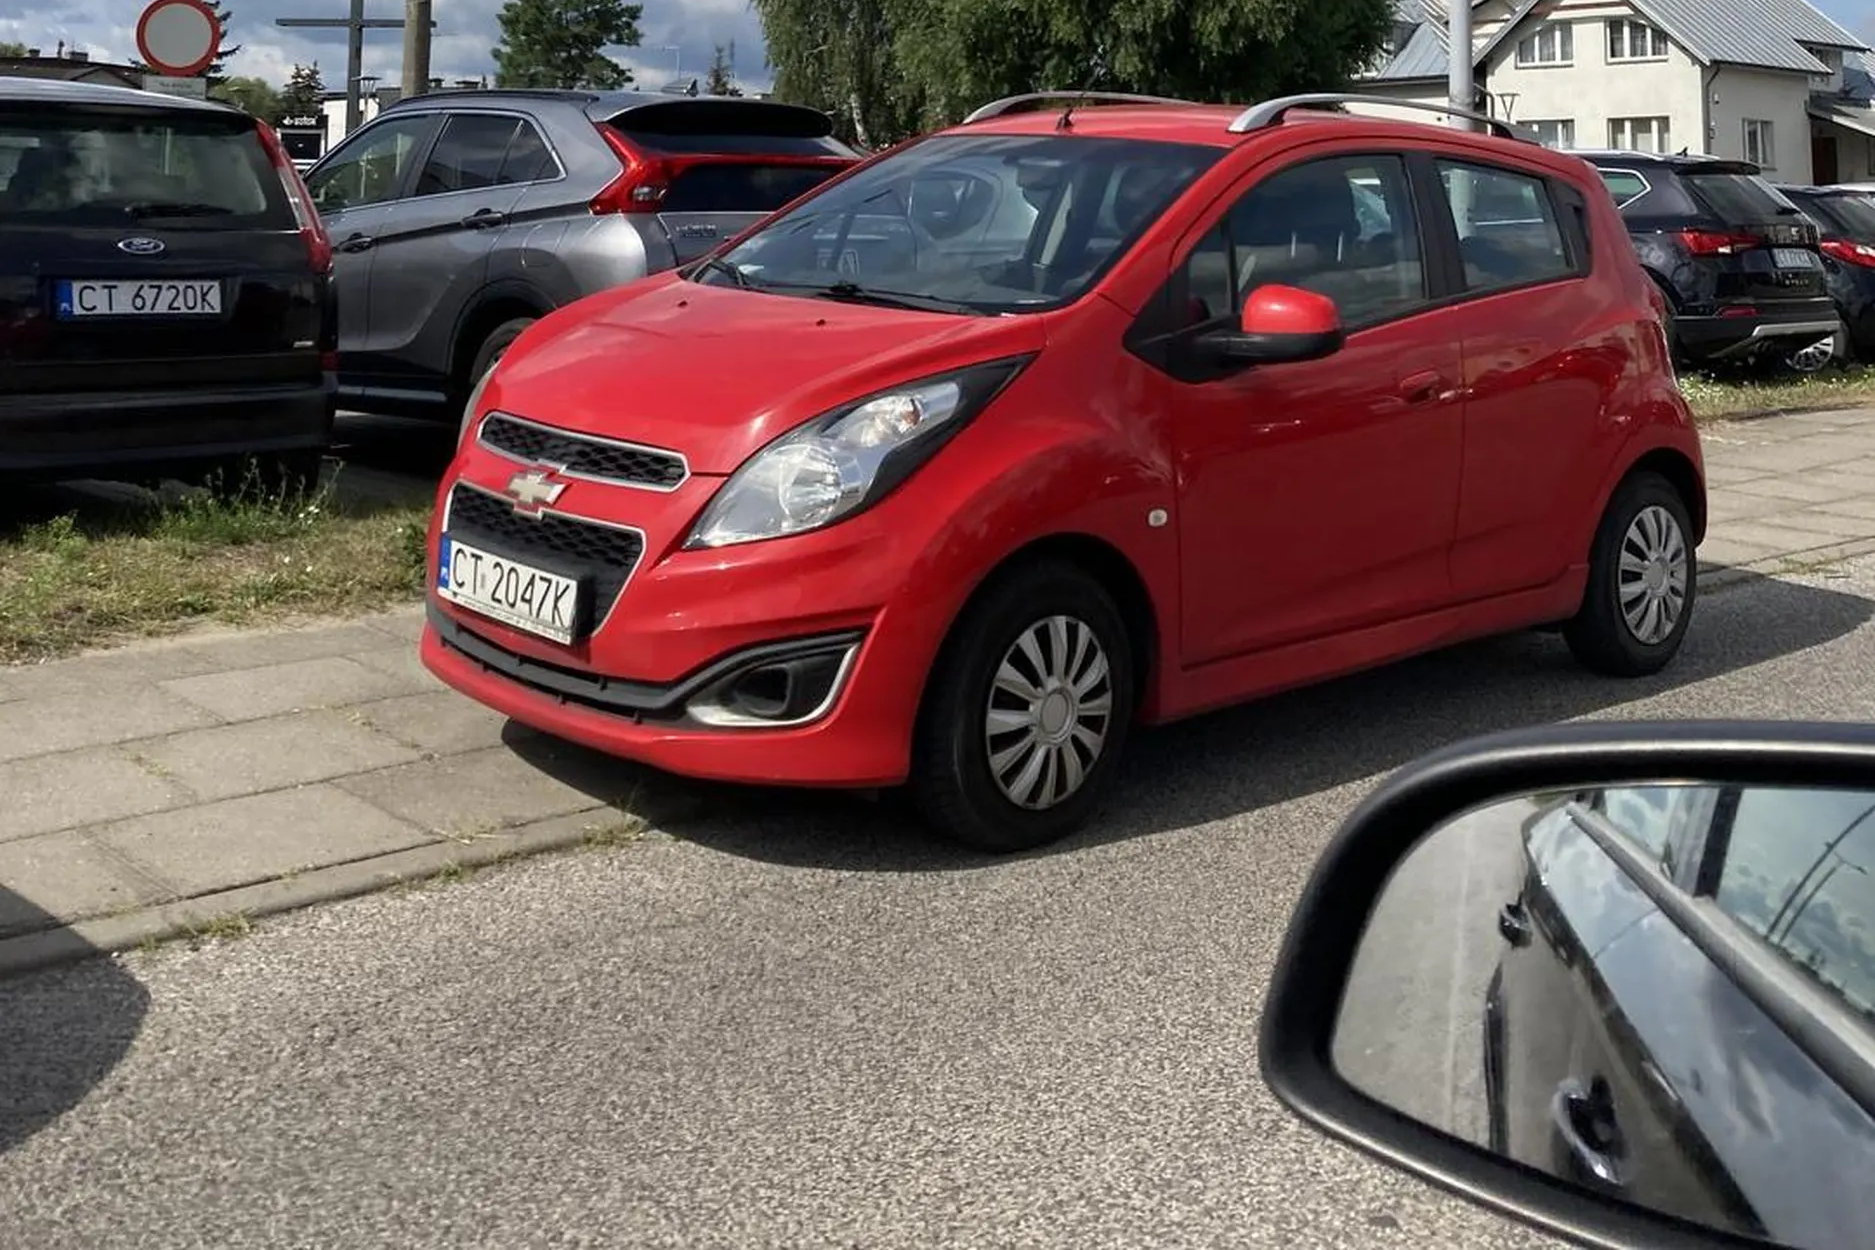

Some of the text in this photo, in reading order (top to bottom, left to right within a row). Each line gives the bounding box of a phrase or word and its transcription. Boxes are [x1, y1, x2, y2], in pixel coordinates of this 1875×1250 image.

[78, 284, 215, 312] CT 6720K
[452, 548, 482, 595] CT
[491, 561, 570, 628] 2047K
